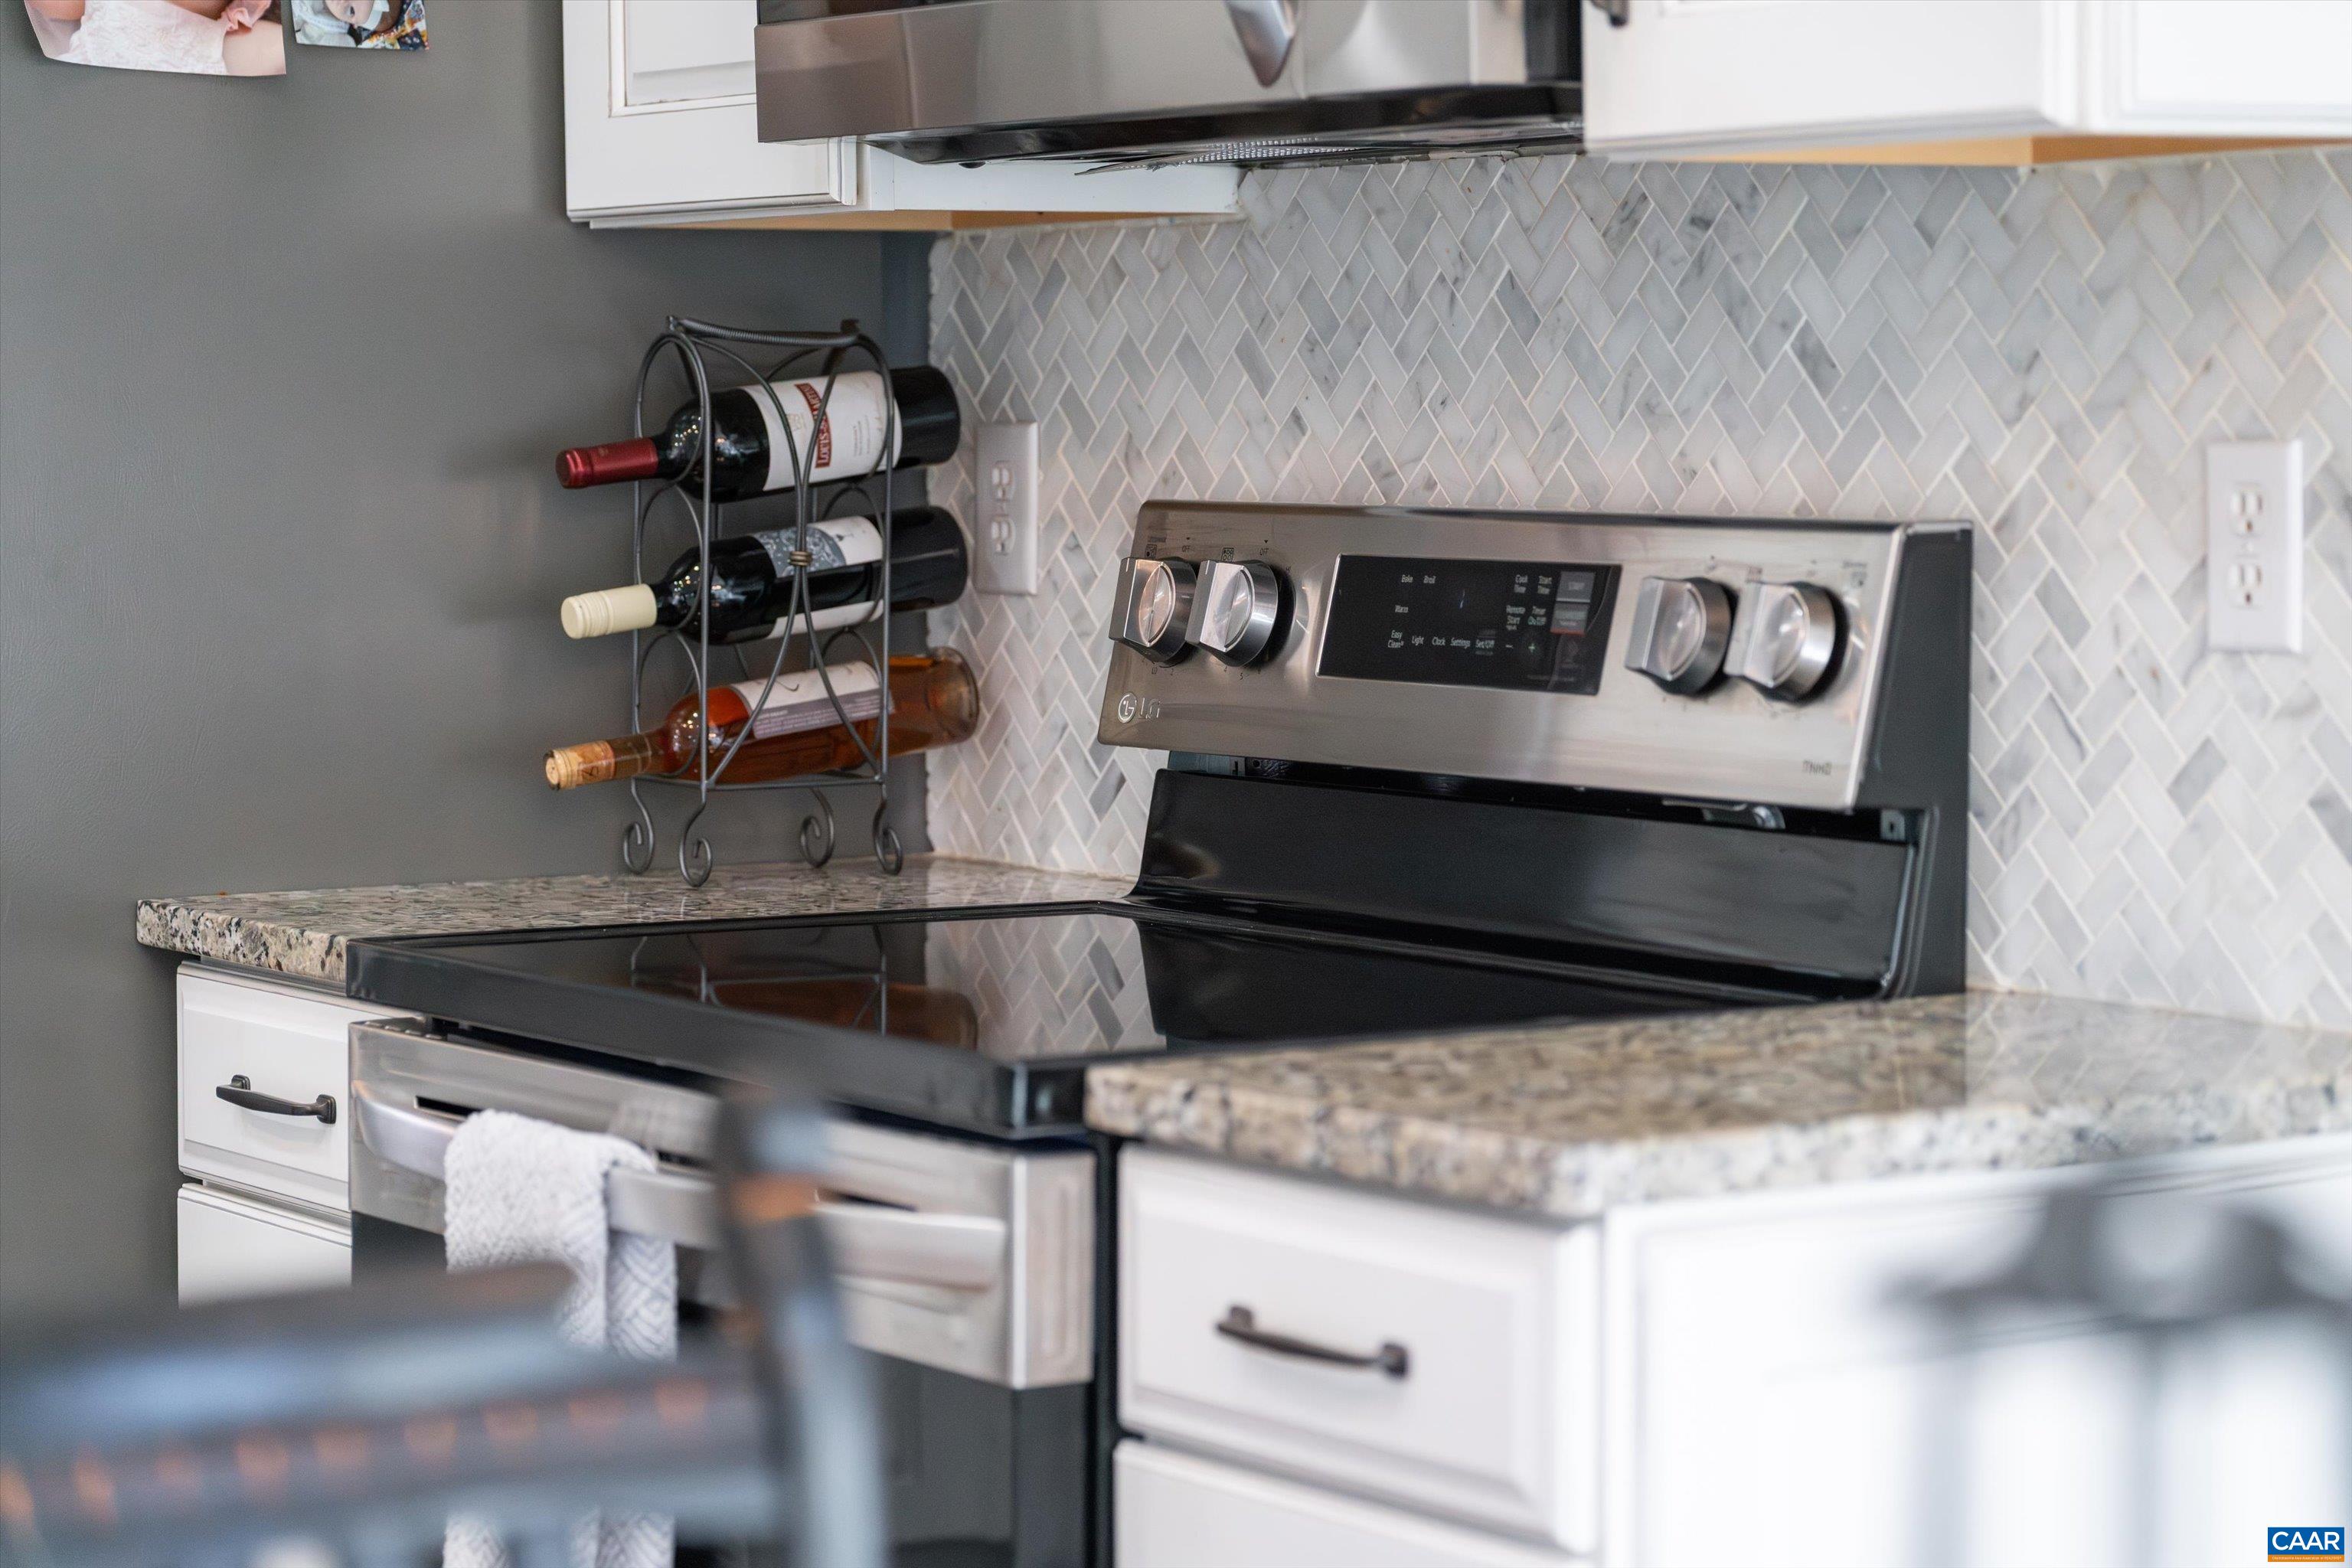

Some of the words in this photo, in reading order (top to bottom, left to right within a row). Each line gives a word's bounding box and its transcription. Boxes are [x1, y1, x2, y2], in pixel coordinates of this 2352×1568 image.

[1391, 629, 1403, 639] Easy
[1412, 635, 1424, 646] Light
[1432, 636, 1446, 646] Clock
[1450, 637, 1471, 649] Settings
